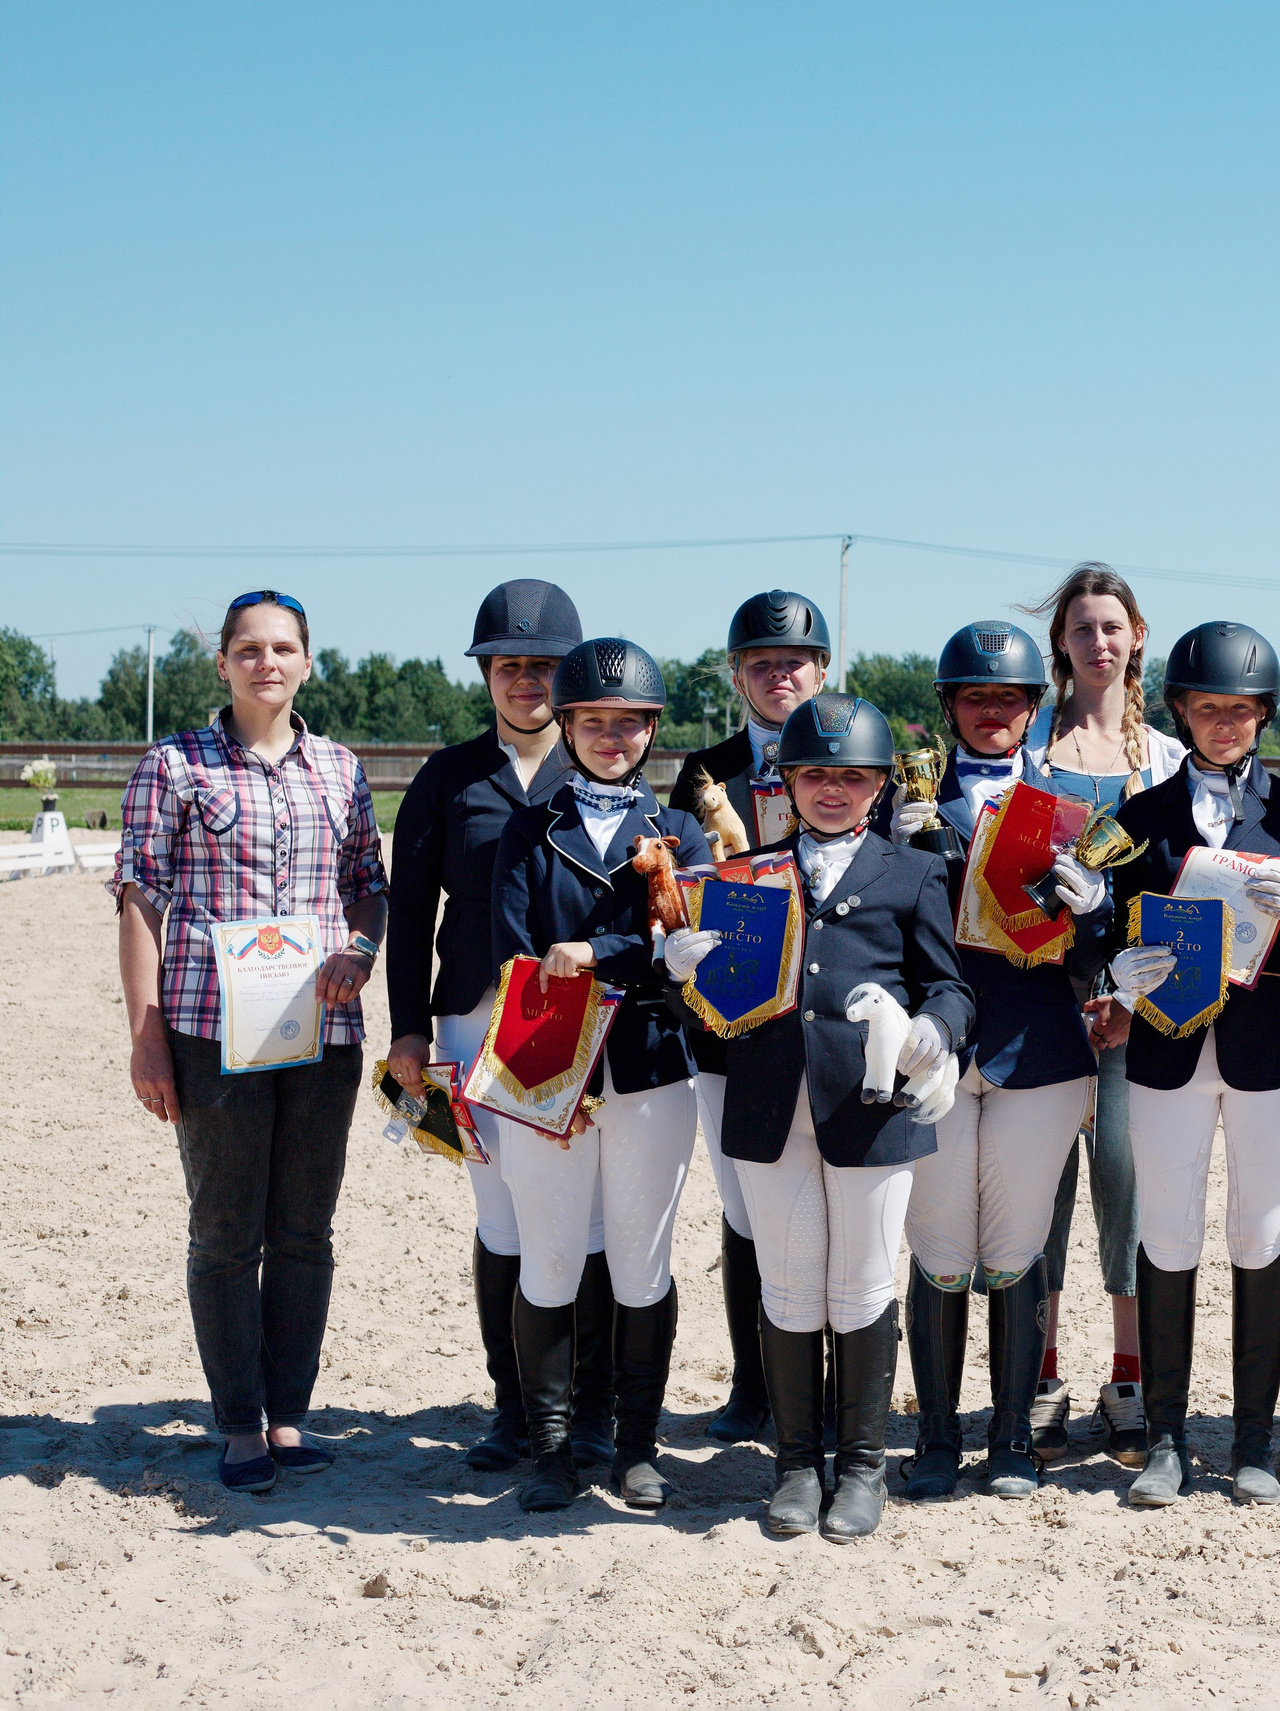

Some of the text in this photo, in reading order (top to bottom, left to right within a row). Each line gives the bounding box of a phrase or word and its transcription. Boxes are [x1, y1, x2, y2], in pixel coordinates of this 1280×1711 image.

[736, 920, 745, 933] 2
[719, 930, 762, 944] МЕСТО
[1176, 930, 1184, 942] 2
[237, 962, 310, 974] БЛАГОДАРСТВЕННОЕ
[259, 972, 290, 980] ПИСЬМО
[525, 1007, 563, 1021] МЕСТО
